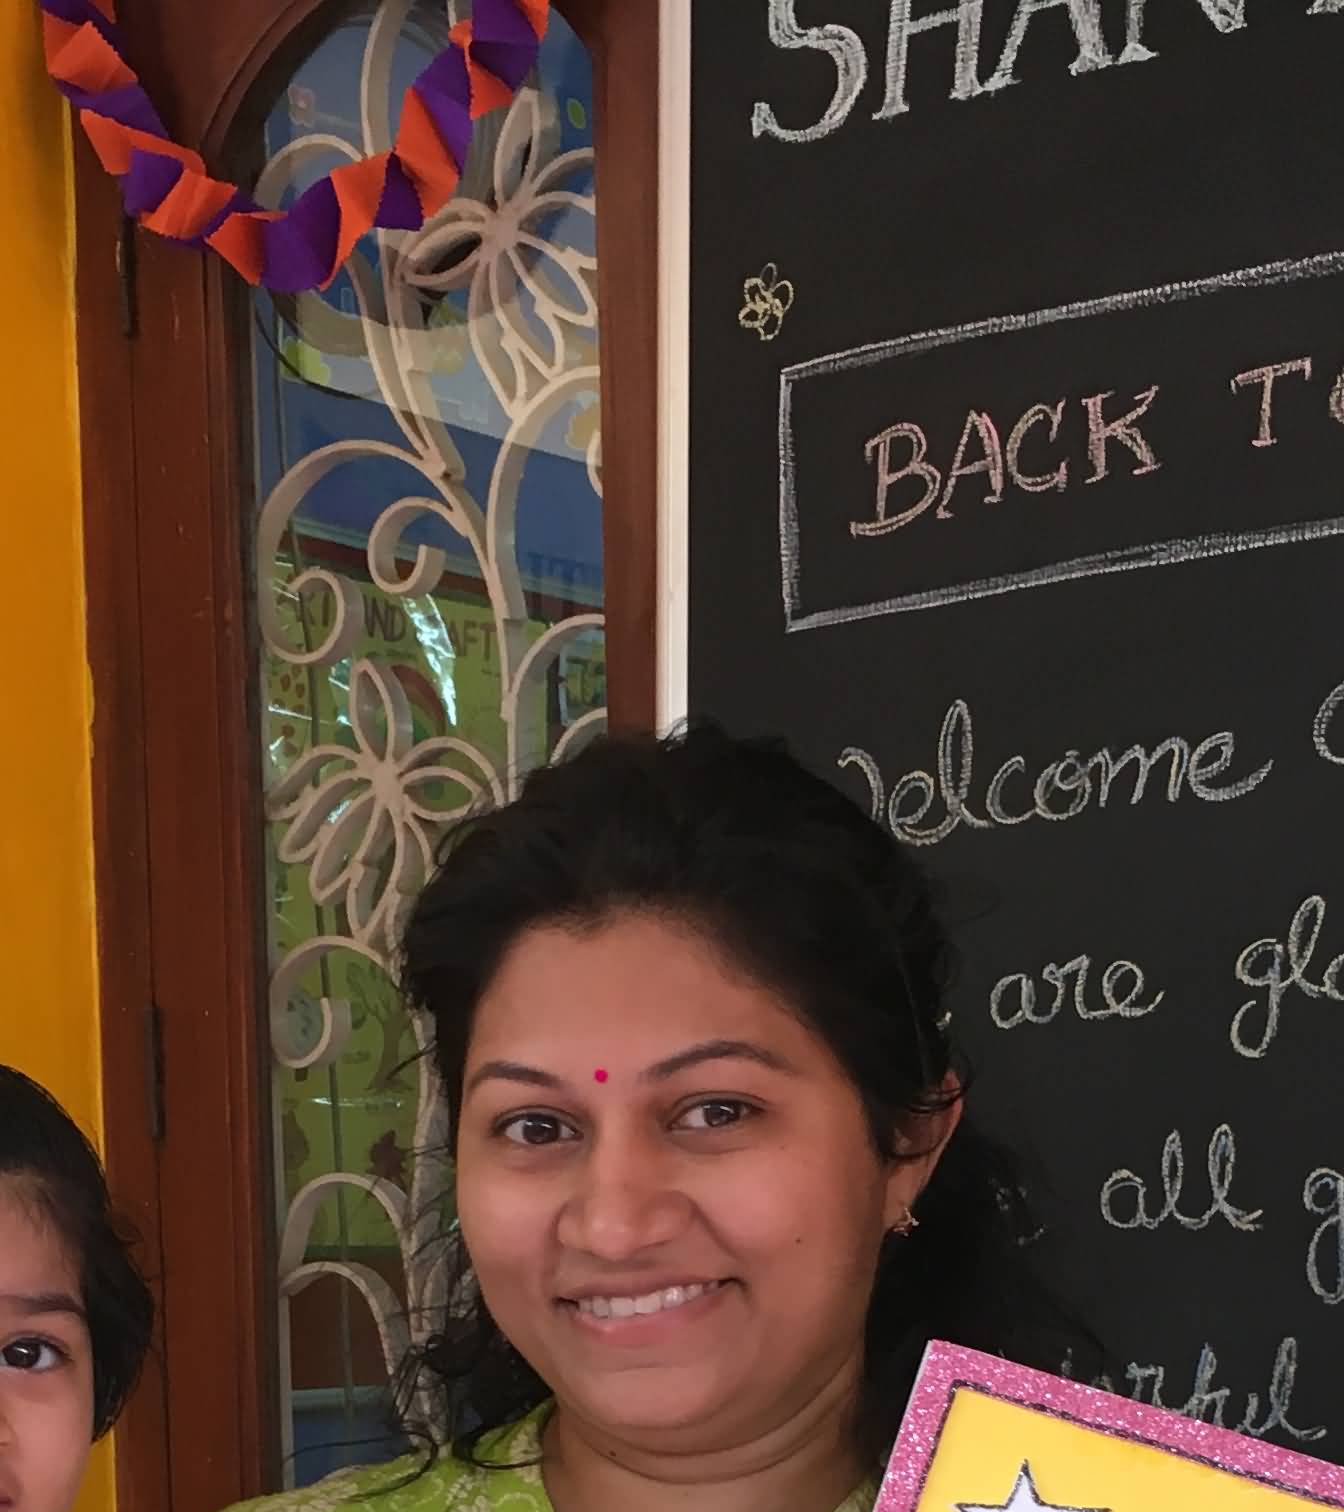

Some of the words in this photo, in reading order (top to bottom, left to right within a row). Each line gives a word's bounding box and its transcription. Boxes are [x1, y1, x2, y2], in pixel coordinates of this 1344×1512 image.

[850, 384, 1161, 538] BACK
[989, 954, 1165, 1030] are
[1100, 1122, 1264, 1230] all
